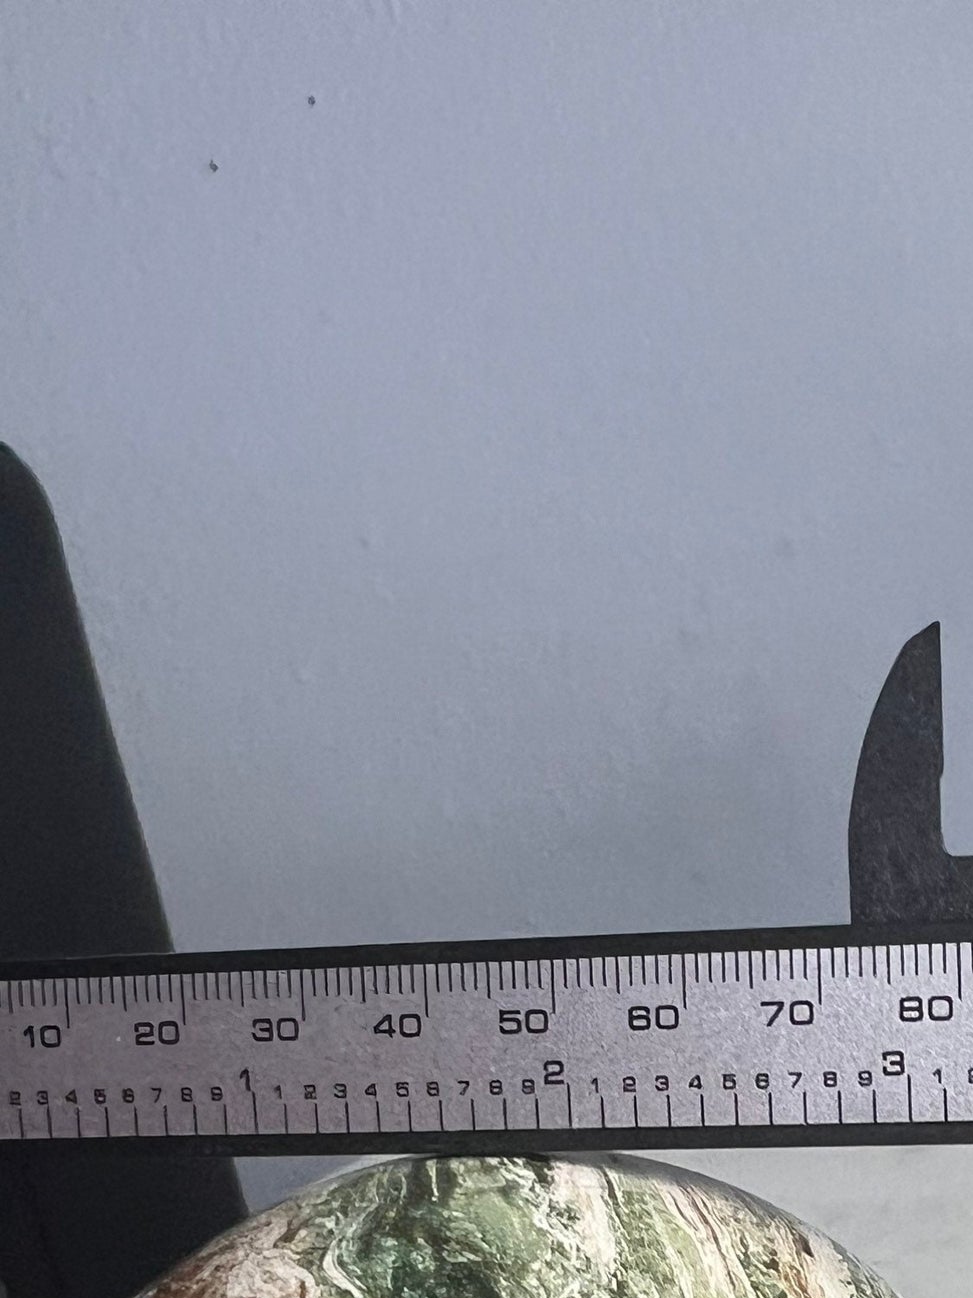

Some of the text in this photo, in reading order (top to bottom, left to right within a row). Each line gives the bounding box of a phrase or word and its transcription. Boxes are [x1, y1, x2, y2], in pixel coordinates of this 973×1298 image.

[23, 996, 953, 1048] 10 20 30 40 50 60 70 80
[151, 1088, 162, 1102] 7
[181, 1087, 193, 1102] 8
[211, 1087, 223, 1101] 9
[240, 1067, 251, 1091] 1
[274, 1085, 282, 1099] 1
[304, 1085, 317, 1099] 2
[334, 1084, 347, 1098] 3
[365, 1083, 377, 1097] 4
[396, 1082, 409, 1097] 5
[426, 1081, 440, 1096] 6
[457, 1081, 470, 1095] 7
[490, 1080, 502, 1095] 8
[522, 1079, 535, 1094] 9
[544, 1060, 564, 1085] 2
[591, 1078, 599, 1093] 1
[623, 1077, 636, 1092] 2
[655, 1076, 669, 1091] 3
[689, 1075, 702, 1090] 4
[723, 1074, 736, 1090] 5
[755, 1073, 769, 1089] 6
[788, 1072, 801, 1088] 7
[823, 1071, 837, 1087] 8
[858, 1071, 873, 1086] 9
[883, 1050, 905, 1076] 3
[932, 1069, 942, 1084] 1
